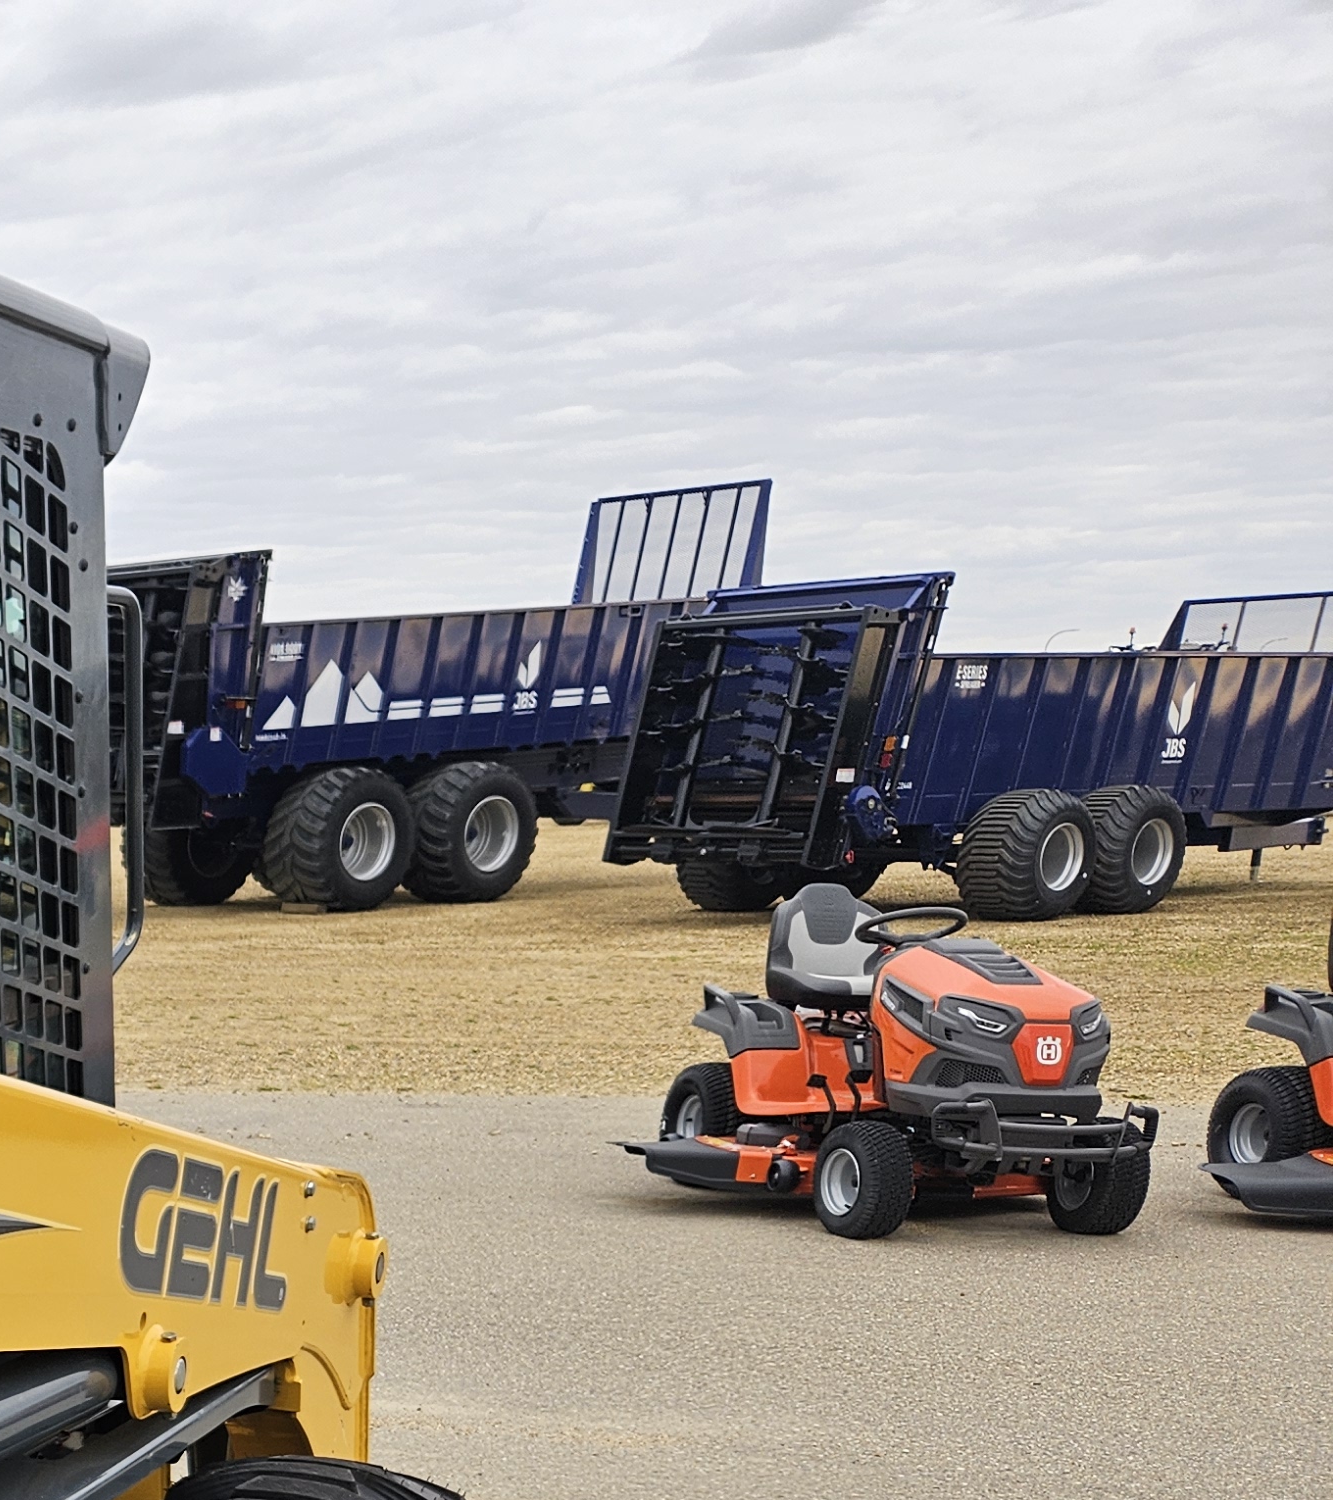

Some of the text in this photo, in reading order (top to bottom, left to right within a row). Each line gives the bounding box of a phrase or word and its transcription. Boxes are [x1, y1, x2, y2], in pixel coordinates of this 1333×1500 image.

[513, 690, 538, 710] JBS
[1161, 738, 1186, 758] JBS
[119, 1144, 288, 1314] GEHL
